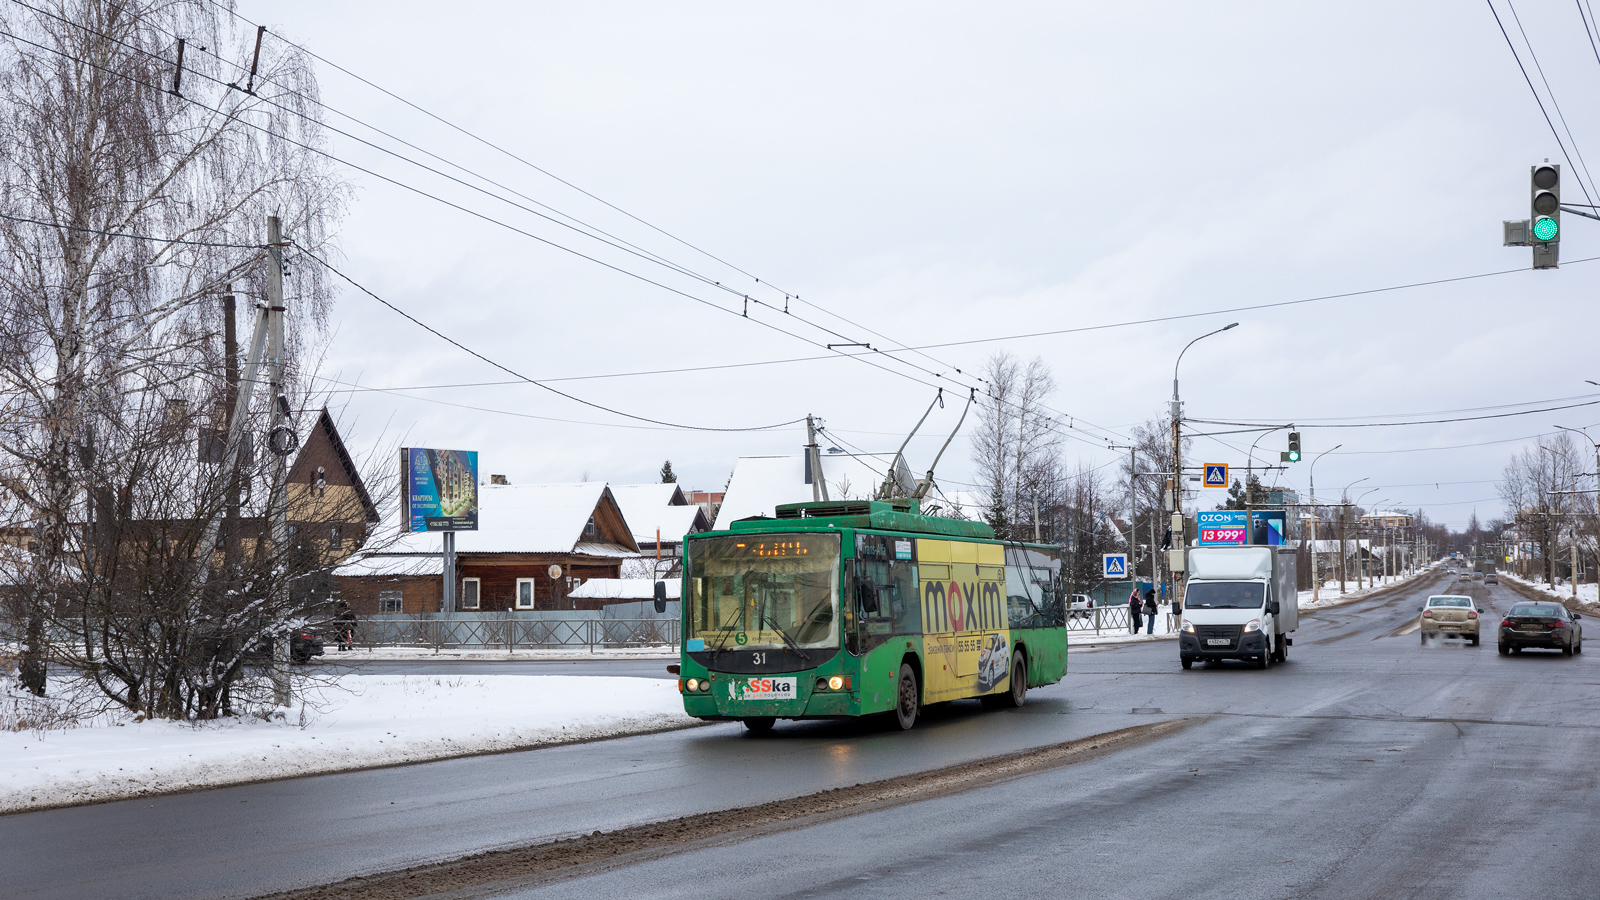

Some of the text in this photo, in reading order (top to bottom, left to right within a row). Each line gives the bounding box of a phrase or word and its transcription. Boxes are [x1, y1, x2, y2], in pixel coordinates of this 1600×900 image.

[1203, 531, 1214, 540] 13
[738, 634, 746, 643] 5
[752, 652, 766, 665] 31
